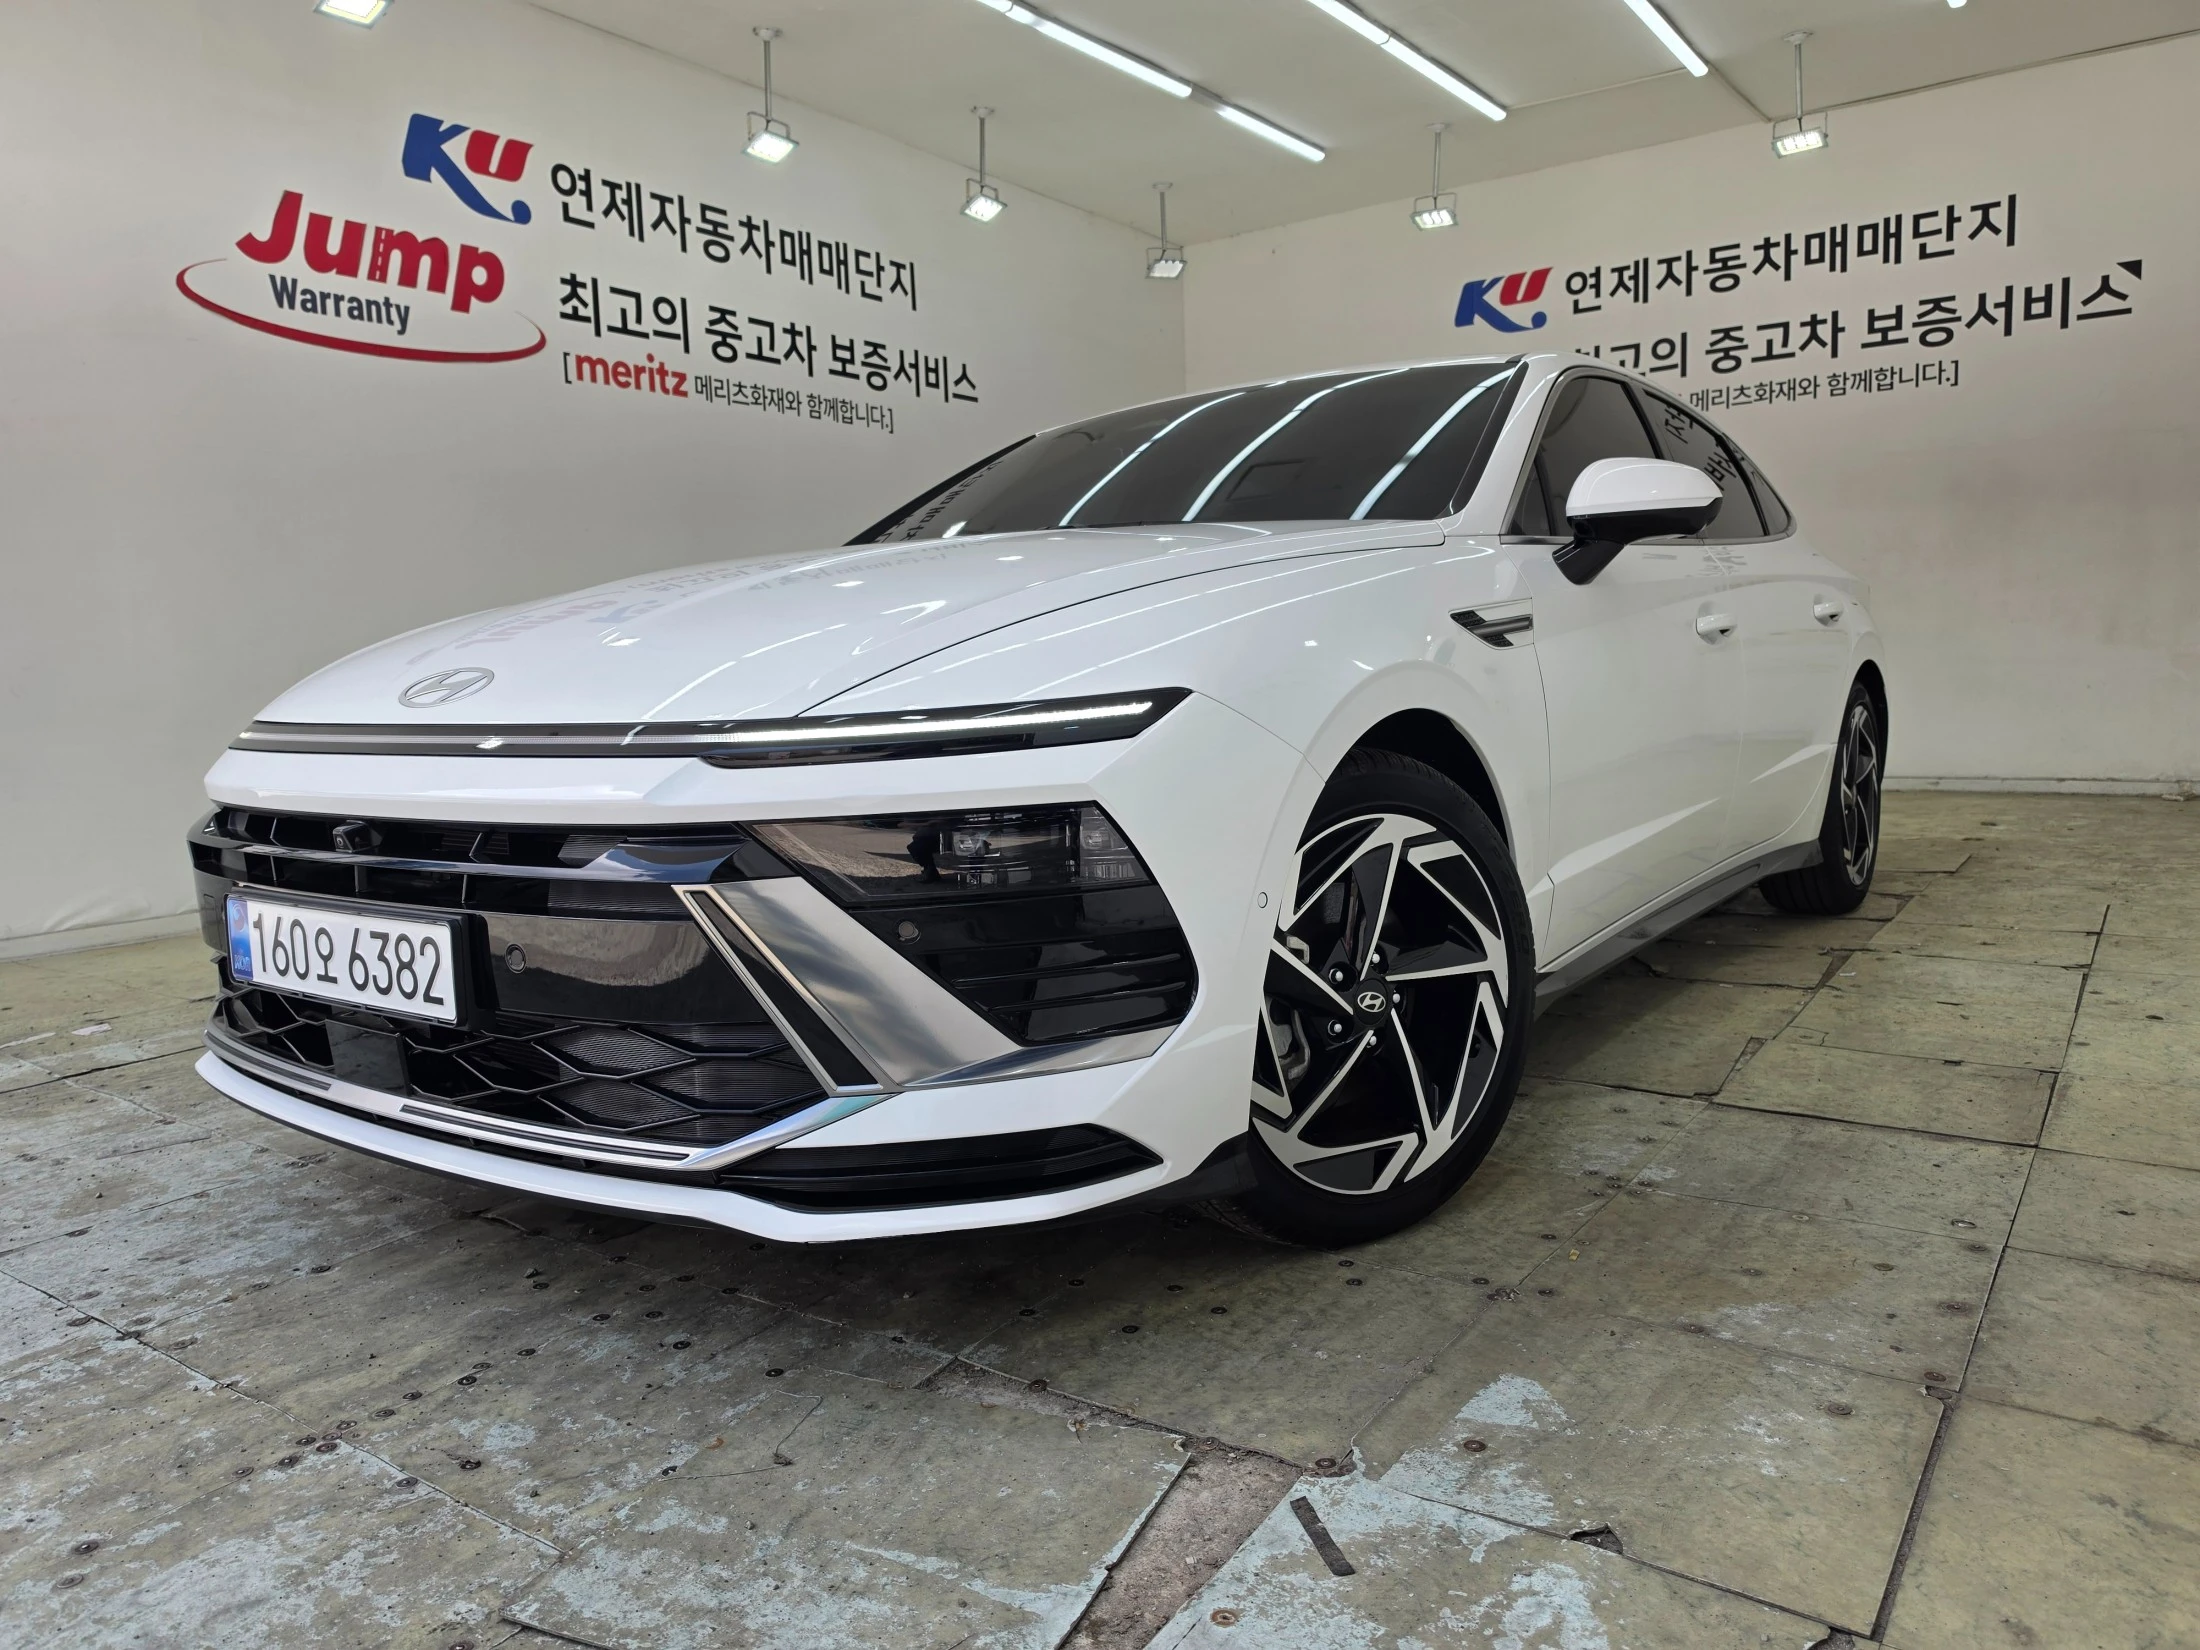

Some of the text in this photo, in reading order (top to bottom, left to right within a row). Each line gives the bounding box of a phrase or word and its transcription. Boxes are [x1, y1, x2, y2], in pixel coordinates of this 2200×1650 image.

[235, 190, 505, 315] Jump
[550, 163, 919, 311] 연제자동차매매단지
[1565, 193, 2017, 315] 연제자동차매매단지
[268, 273, 410, 336] Warranty
[559, 273, 980, 404] 최고의 중고차 보증서비스
[1575, 274, 2133, 378] 고의 중고차 보증서비스
[694, 375, 803, 417] 메리츠화재와
[806, 392, 895, 434] 함께합니다.]
[1689, 359, 1960, 412] 메리츠화재와 함께합니다.]
[253, 913, 445, 1006] 160오 6382
